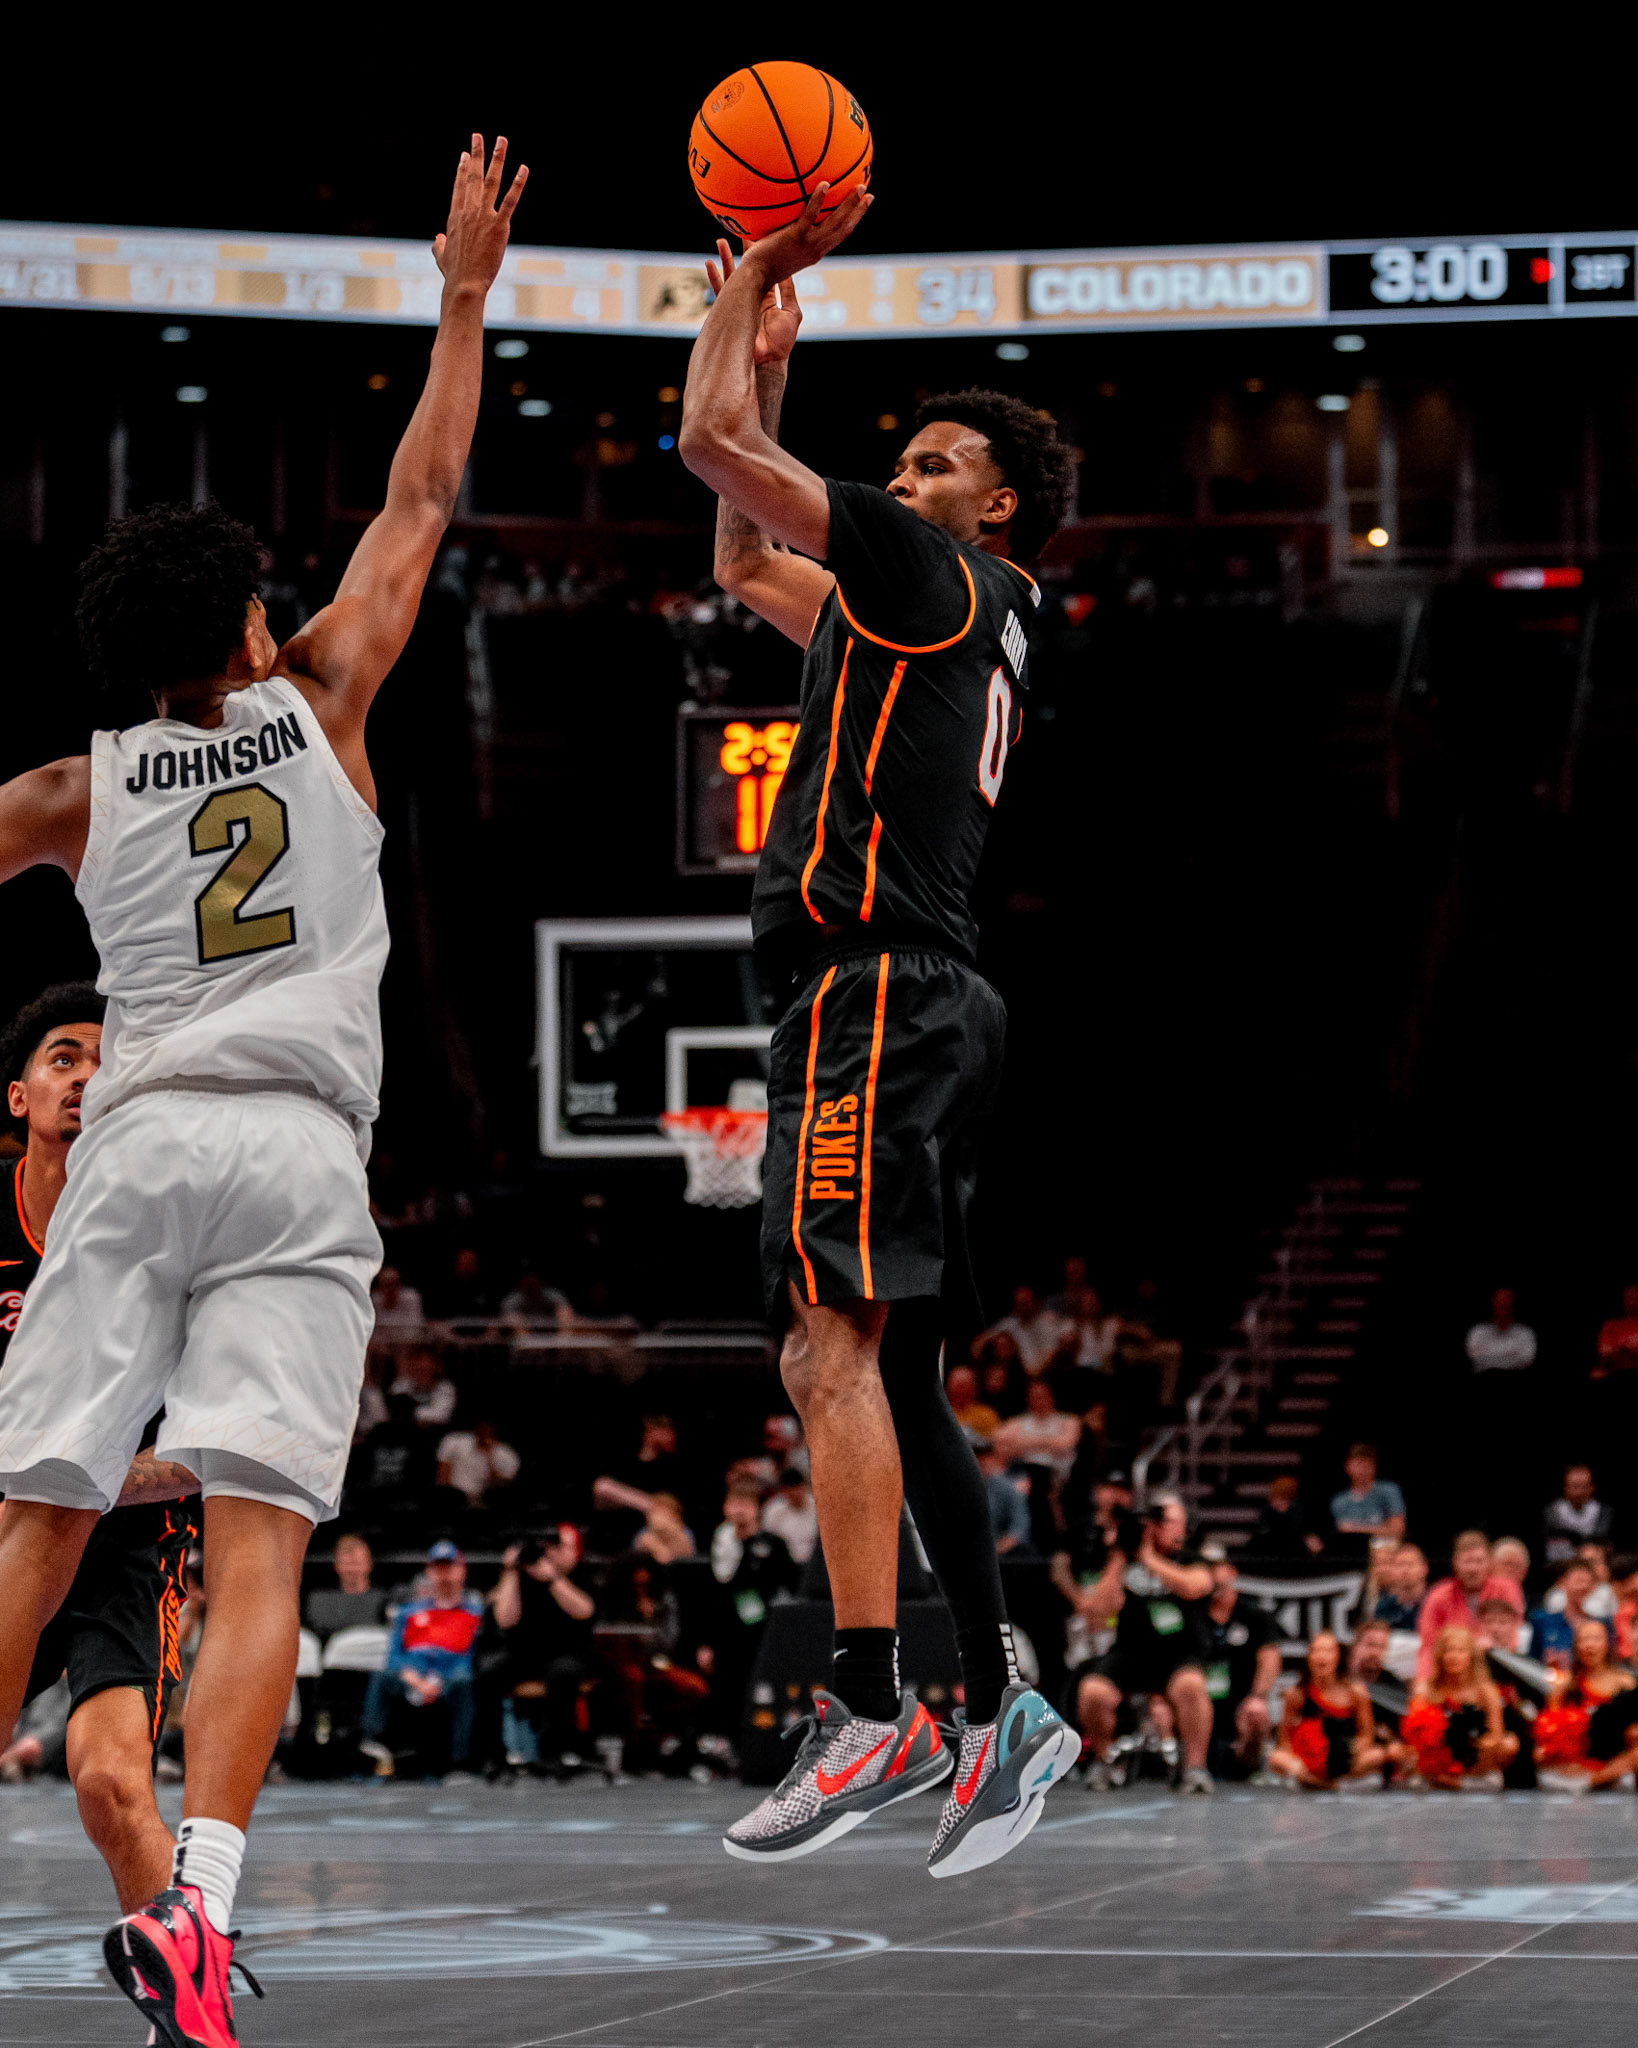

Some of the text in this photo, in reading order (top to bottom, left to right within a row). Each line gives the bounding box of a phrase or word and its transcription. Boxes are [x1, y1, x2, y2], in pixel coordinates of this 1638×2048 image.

[916, 267, 998, 326] 34
[1027, 259, 1313, 315] COLORADO
[1371, 244, 1509, 304] 3:00
[126, 712, 308, 794] JOHNSON
[978, 665, 1011, 808] 0
[188, 782, 297, 966] 2
[809, 1093, 859, 1200] POKES
